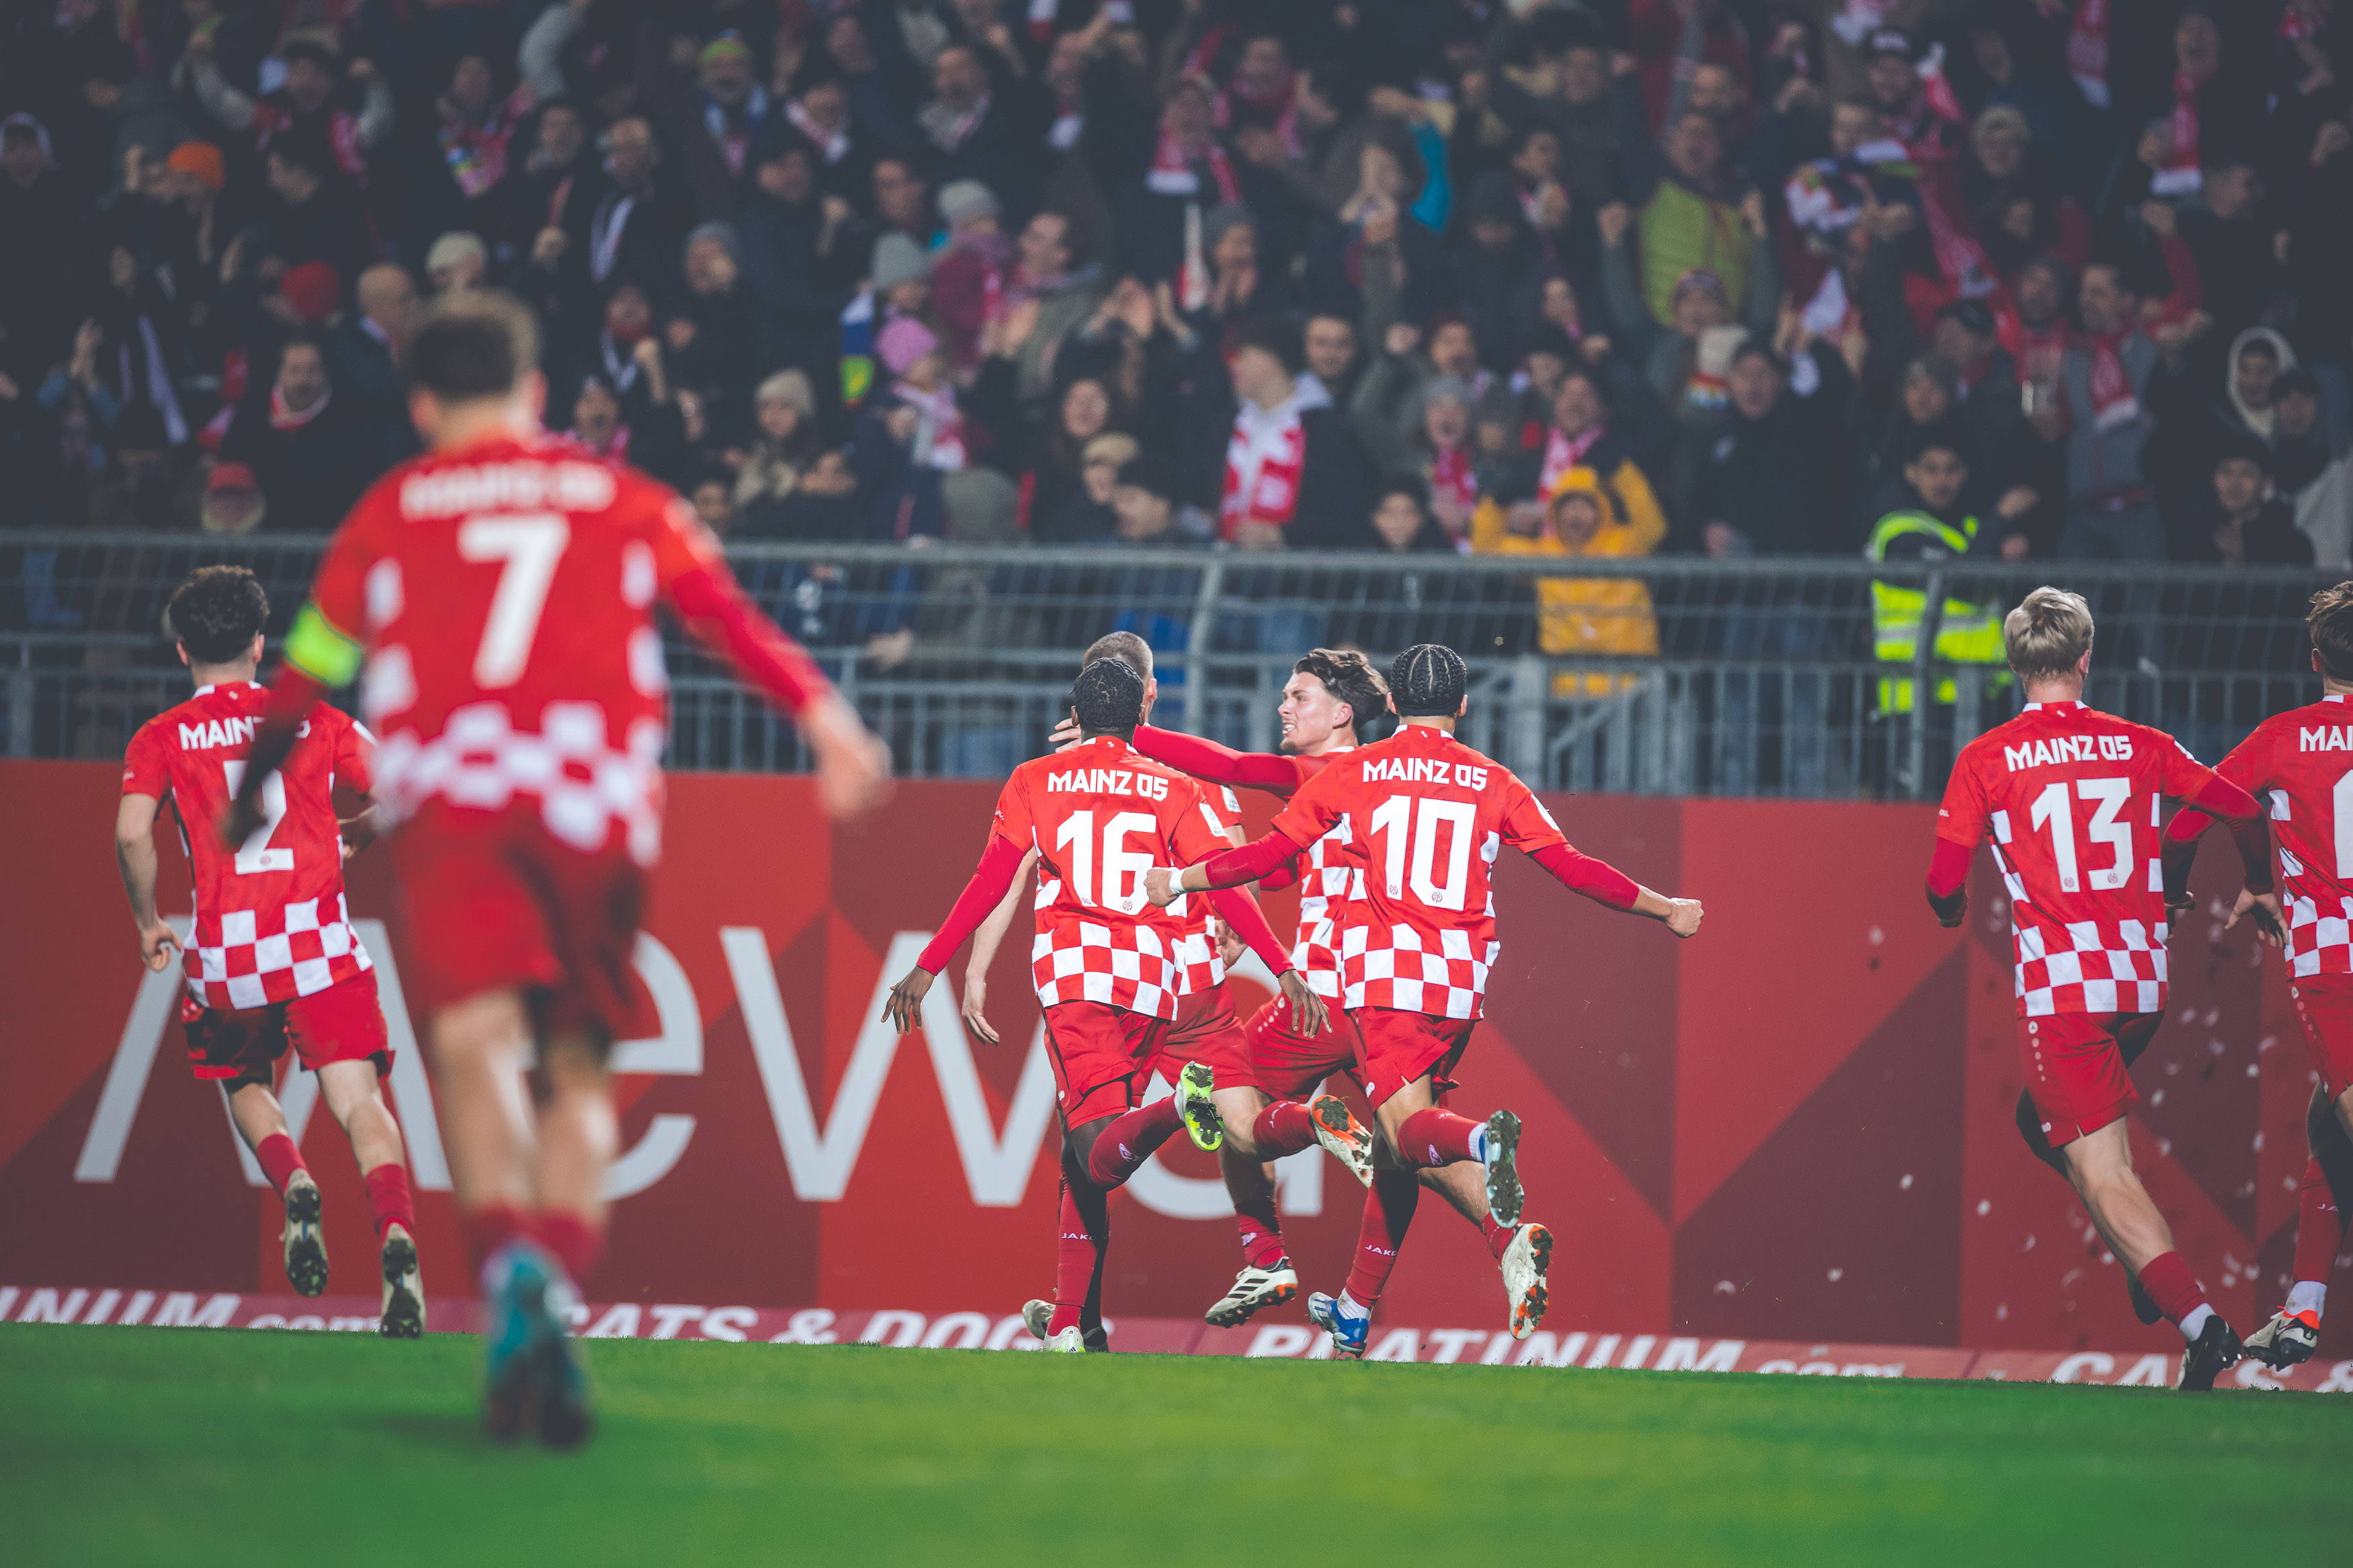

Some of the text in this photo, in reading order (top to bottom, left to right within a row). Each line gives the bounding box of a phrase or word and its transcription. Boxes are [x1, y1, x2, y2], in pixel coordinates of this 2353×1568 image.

[458, 513, 570, 688] 7
[1047, 768, 1168, 801] MAINZ 05
[1363, 757, 1488, 792] MAINZ 05
[2004, 735, 2134, 772] MAINZ 05
[223, 759, 294, 875] 2
[1055, 810, 1156, 915] 16
[1370, 794, 1478, 911] 10
[2030, 777, 2135, 893] 13
[2048, 1352, 2294, 1391] CAS
